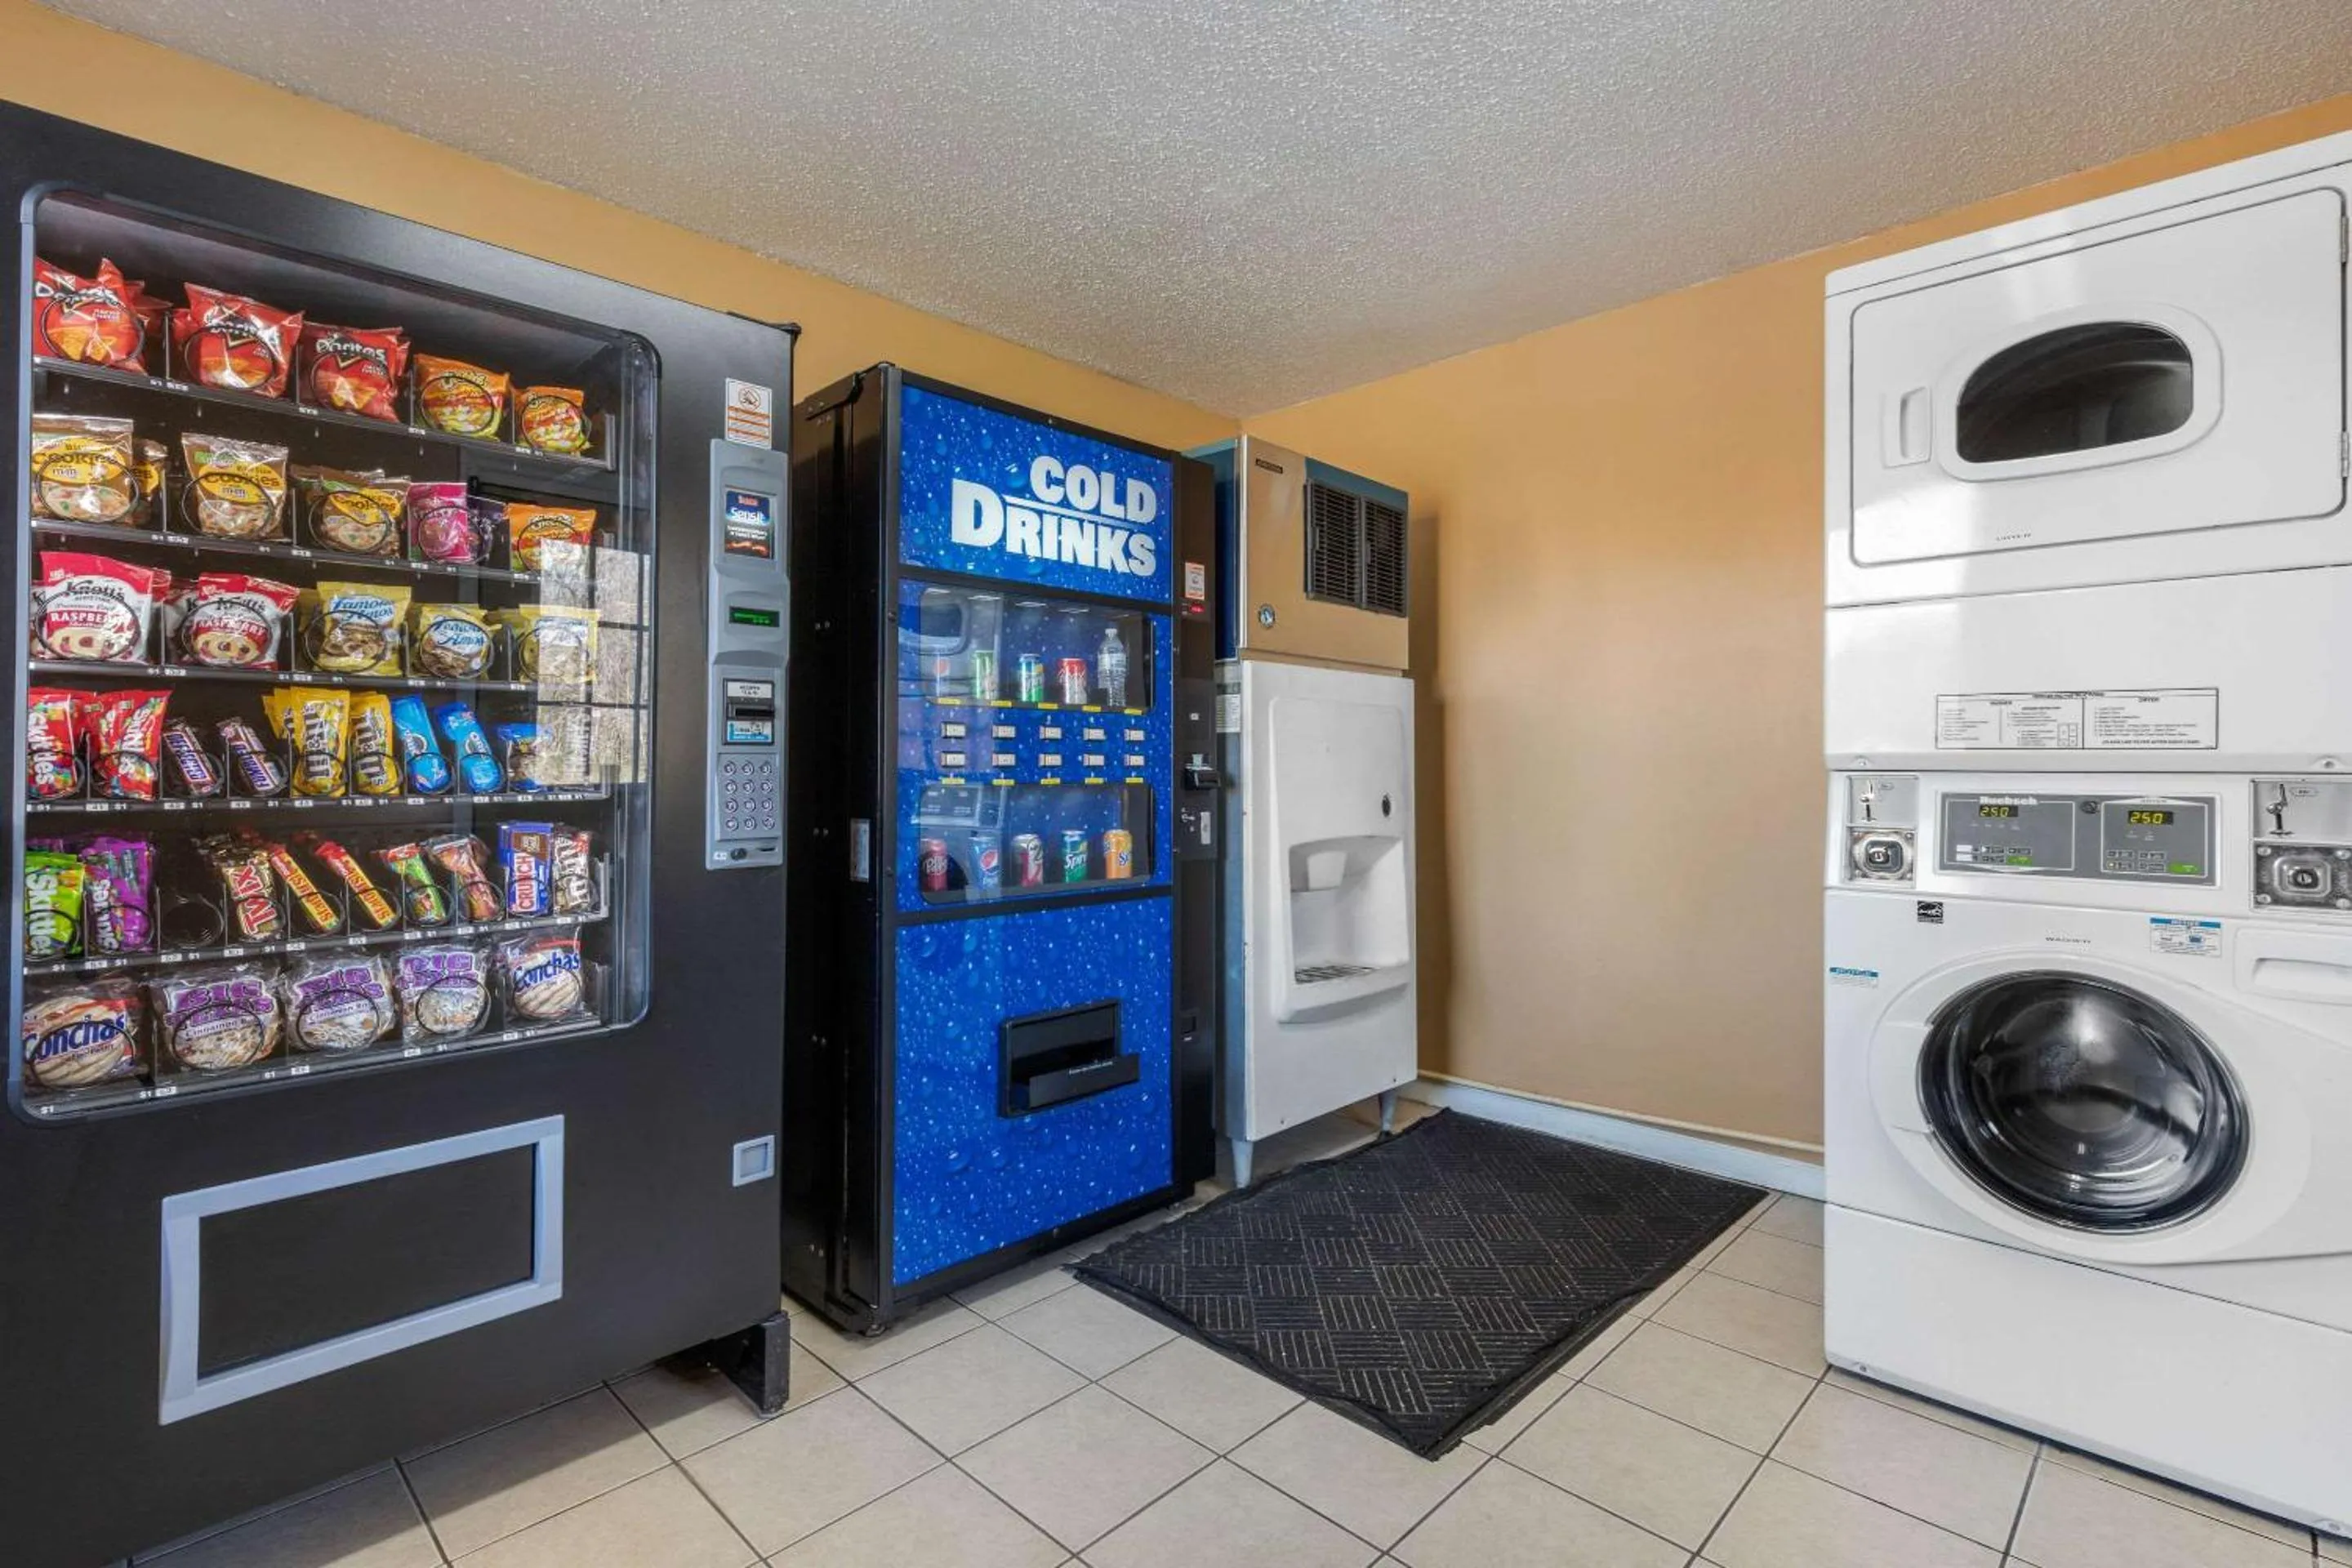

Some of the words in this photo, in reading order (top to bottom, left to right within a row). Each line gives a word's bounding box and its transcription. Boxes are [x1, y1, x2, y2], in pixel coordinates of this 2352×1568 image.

[1030, 456, 1156, 523] COLD
[951, 479, 1156, 577] DRINKS
[51, 612, 126, 626] RASPBE
[1980, 806, 2009, 817] 250
[2129, 812, 2163, 824] 250
[518, 853, 537, 912] CRUNCH
